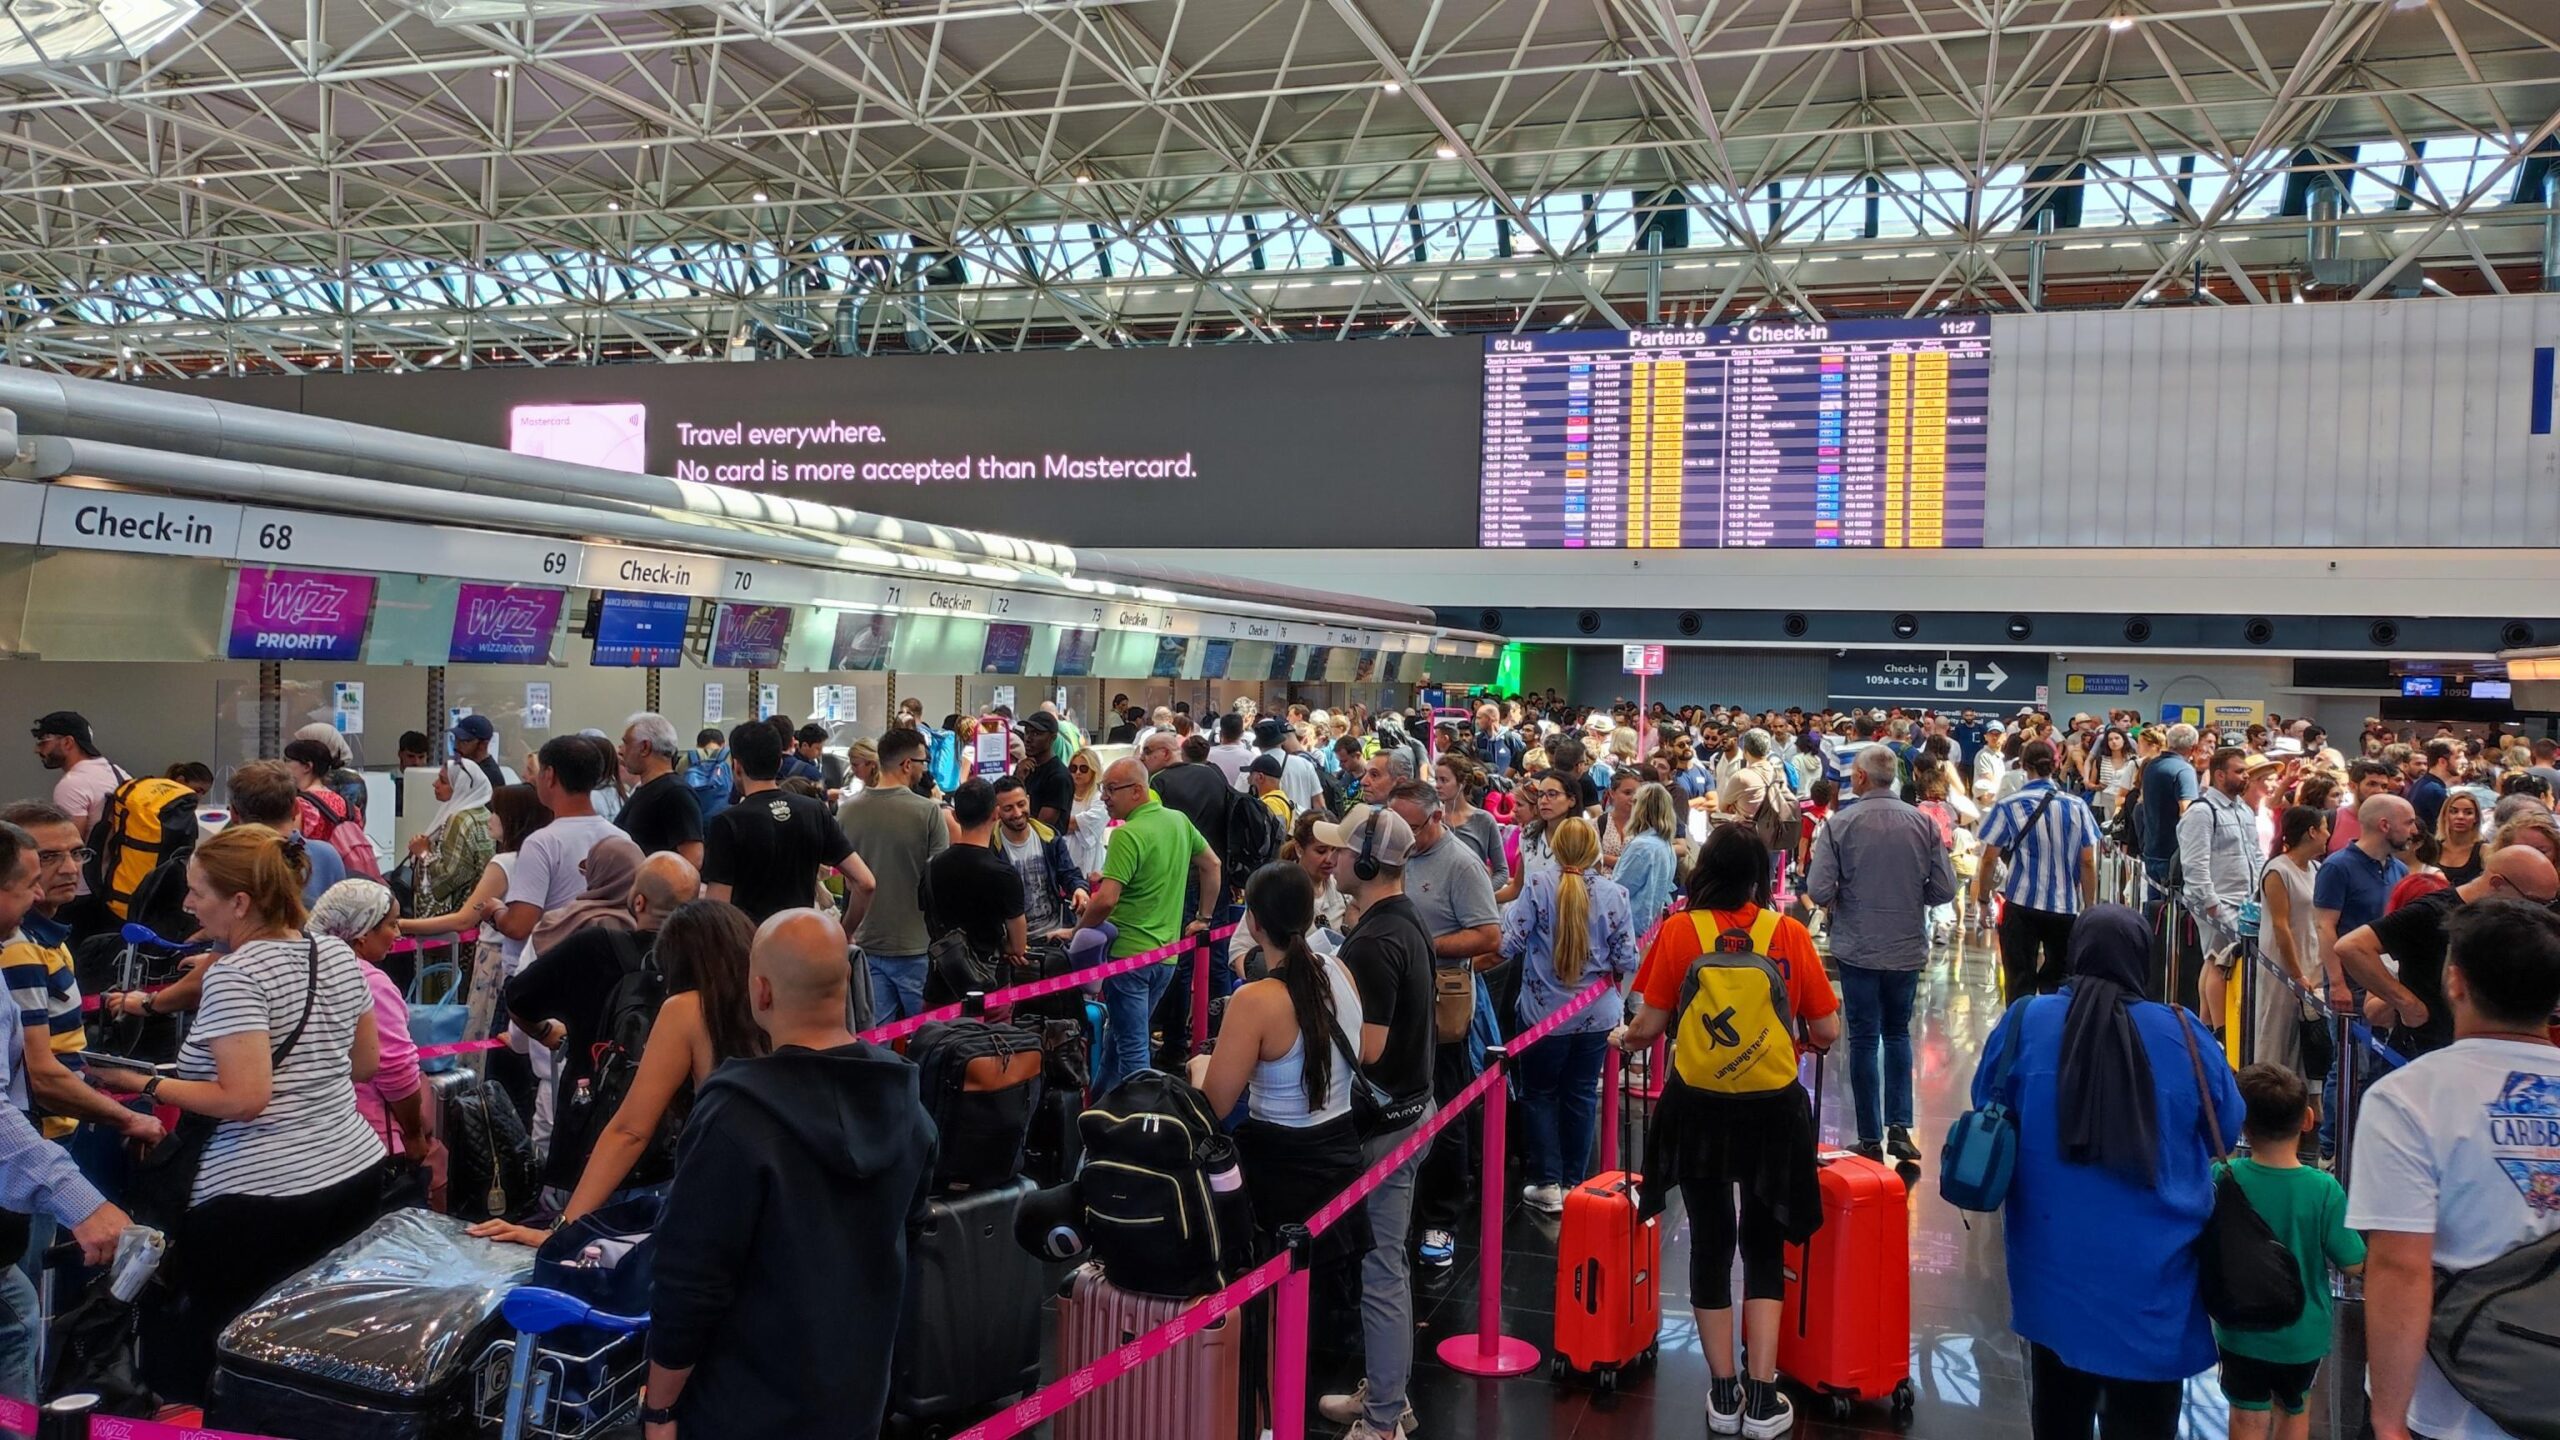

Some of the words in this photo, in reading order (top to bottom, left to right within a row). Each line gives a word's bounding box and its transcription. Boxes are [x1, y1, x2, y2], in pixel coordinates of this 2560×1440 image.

[1748, 326, 1828, 342] Check-in
[1940, 322, 1976, 334] 11:27
[1494, 340, 1508, 350] 02
[1510, 339, 1532, 352] Lug
[1630, 332, 1706, 347] Partenze
[676, 421, 742, 446] Travel
[748, 419, 887, 449] everywhere.
[677, 459, 709, 482] No
[714, 458, 764, 482] card
[771, 457, 788, 482] is
[795, 459, 855, 482] more
[862, 455, 970, 485] accepted
[978, 455, 1035, 480] than
[1045, 452, 1197, 479] Mastercard.
[75, 506, 212, 545] Check-in
[259, 523, 293, 550] 68
[543, 552, 567, 574] 69
[620, 560, 691, 586] Check-in
[734, 572, 752, 591] 70
[888, 587, 901, 604] 71
[929, 591, 971, 611] Check-in
[997, 598, 1009, 613] 72
[1092, 608, 1102, 622] 73
[1119, 611, 1148, 626] Check-in
[1164, 616, 1173, 628] 74
[1248, 624, 1270, 636] Check-in
[256, 632, 337, 649] PRIORITY
[1341, 633, 1357, 644] Check-in
[478, 641, 535, 654] wizzair.com
[1884, 664, 1928, 674] Check-in
[1865, 675, 1928, 686] 109A-B-C-D-E
[2444, 688, 2470, 696] 109D
